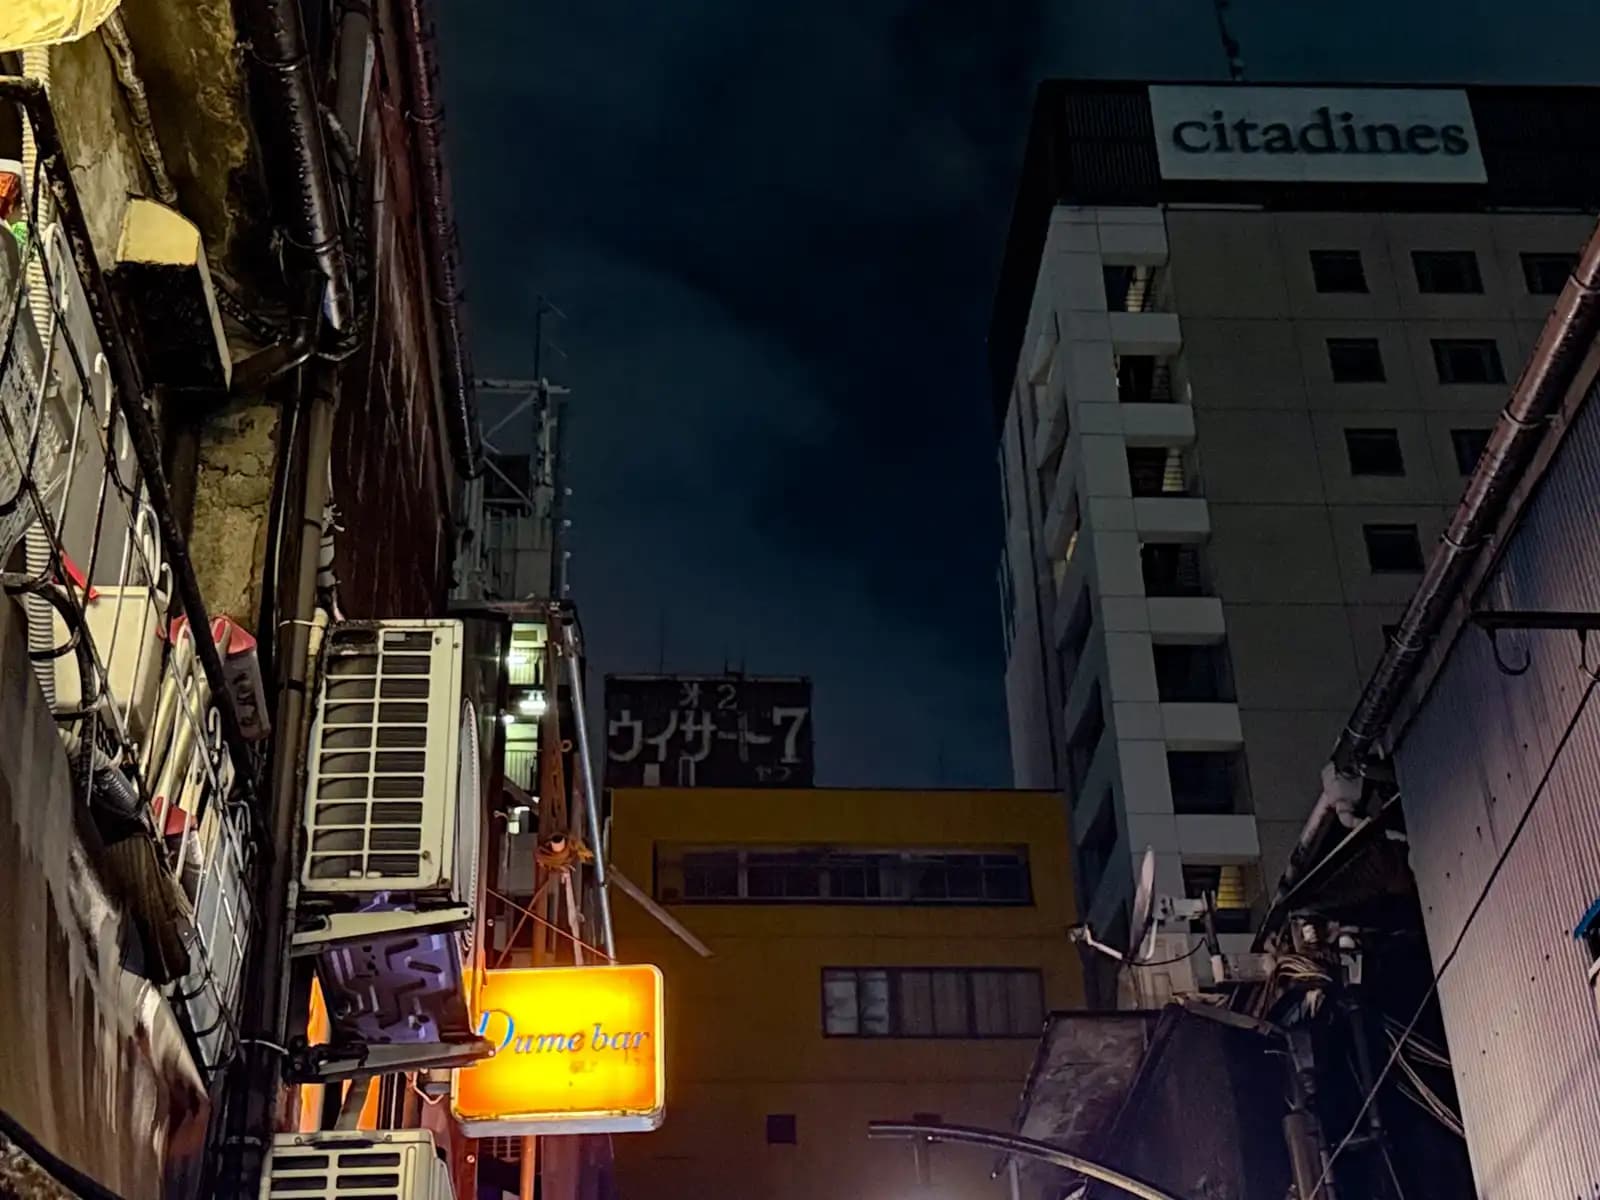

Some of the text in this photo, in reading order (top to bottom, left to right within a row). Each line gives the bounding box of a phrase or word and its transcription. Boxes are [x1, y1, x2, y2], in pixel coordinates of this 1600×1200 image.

[1172, 106, 1470, 156] citadines
[477, 1009, 650, 1054] Dume bar
